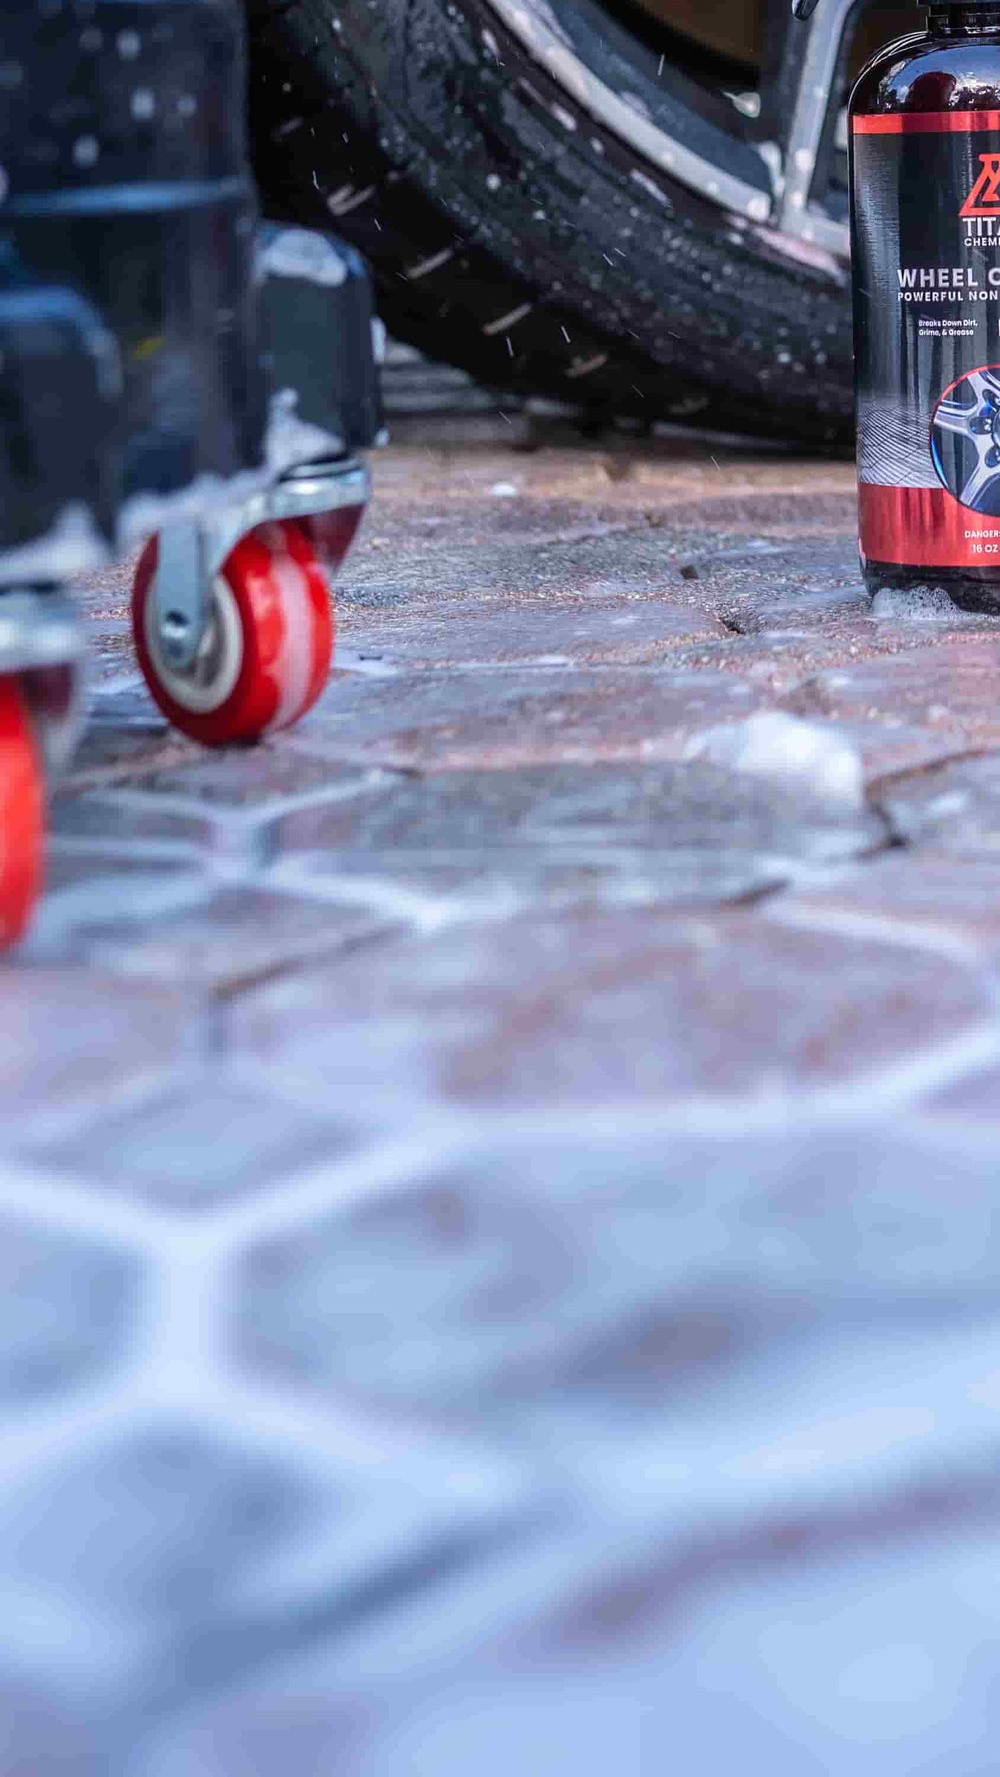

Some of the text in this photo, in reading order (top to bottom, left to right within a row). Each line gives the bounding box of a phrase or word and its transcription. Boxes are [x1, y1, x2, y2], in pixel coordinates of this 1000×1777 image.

[897, 268, 978, 288] WHEEL
[897, 291, 964, 302] POWERFUL
[918, 319, 941, 327] Breaks
[941, 319, 962, 327] Down
[941, 328, 948, 336] &
[948, 328, 974, 336] Grease
[972, 544, 982, 553] 16
[984, 543, 998, 553] OZ
